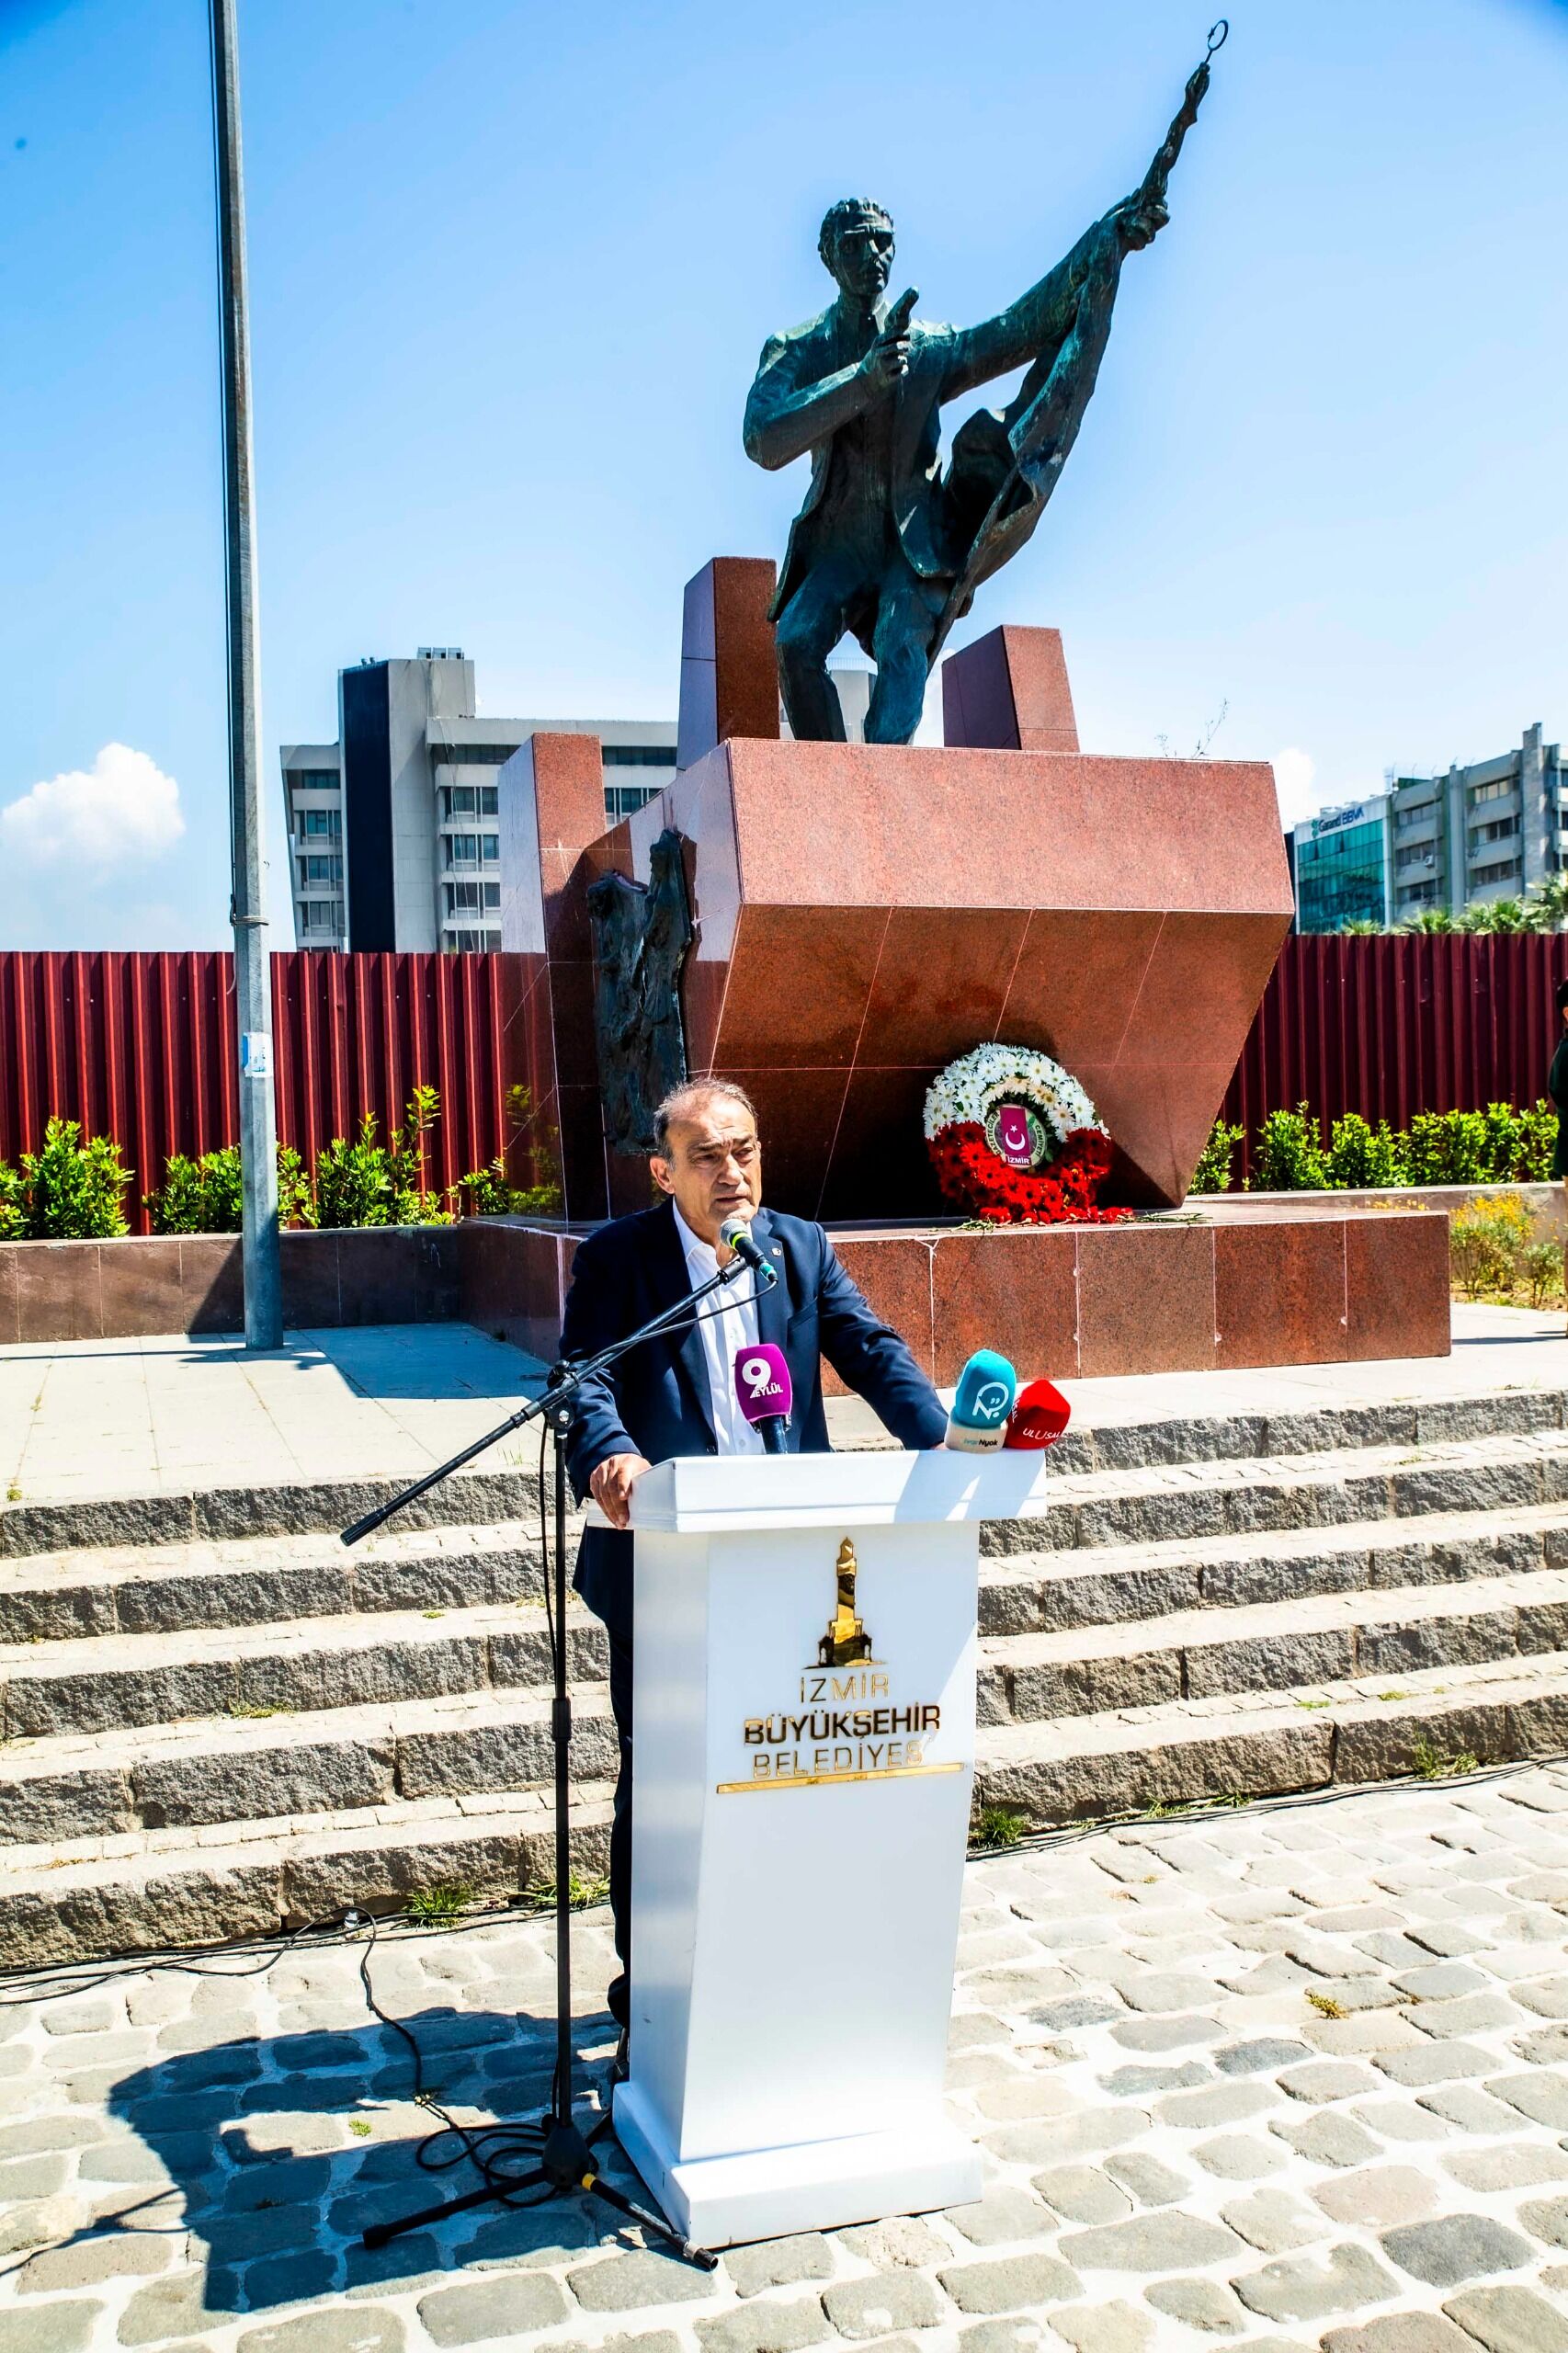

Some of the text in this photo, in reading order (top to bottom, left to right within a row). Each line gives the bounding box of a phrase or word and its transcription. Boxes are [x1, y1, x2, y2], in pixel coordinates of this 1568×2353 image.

[1342, 805, 1365, 824] BBVA
[742, 1358, 772, 1399] 9
[755, 1381, 784, 1398] EYLÜL
[800, 1672, 890, 1703] İZMİR
[743, 1701, 941, 1747] BÜYÜKŞEHİR
[753, 1736, 934, 1779] BELEDİYES
